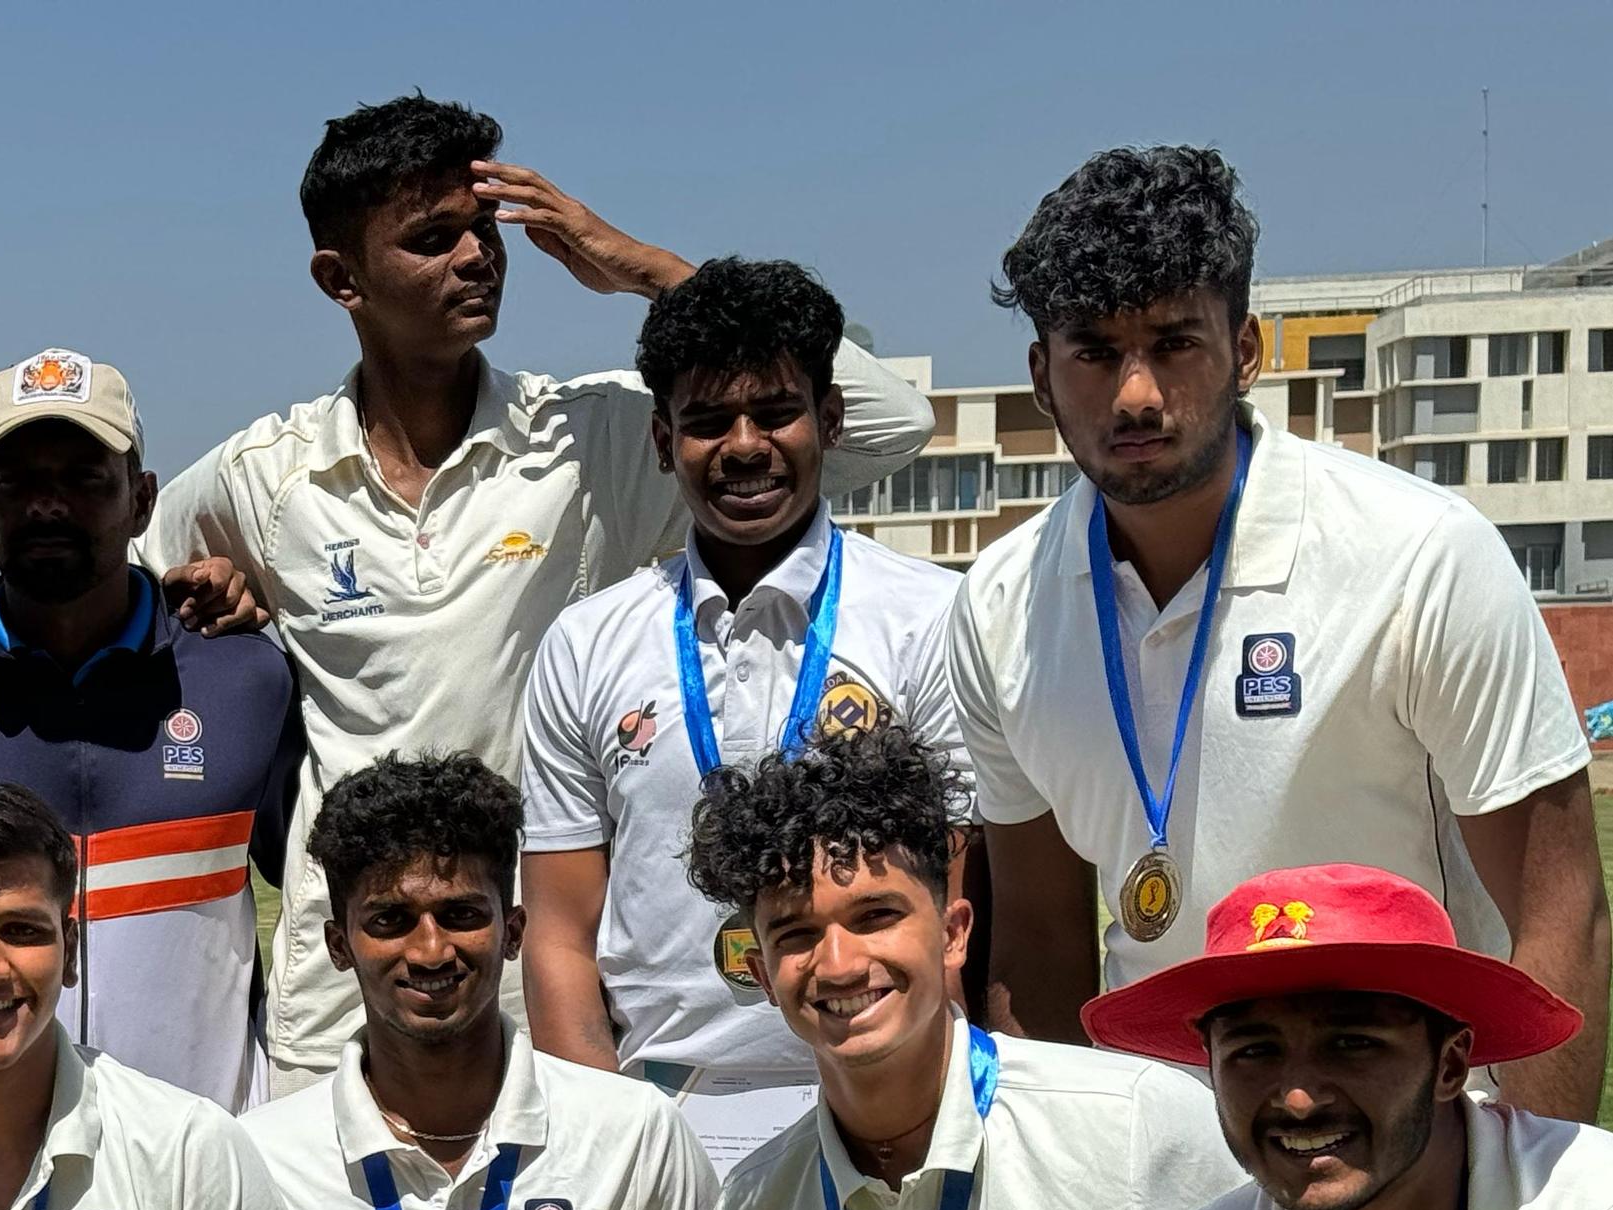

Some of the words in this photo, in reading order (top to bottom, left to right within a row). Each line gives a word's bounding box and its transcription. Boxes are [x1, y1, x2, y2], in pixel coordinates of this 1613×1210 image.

[322, 604, 385, 622] MERCHANTS
[1243, 676, 1292, 696] PES
[163, 745, 205, 765] PES
